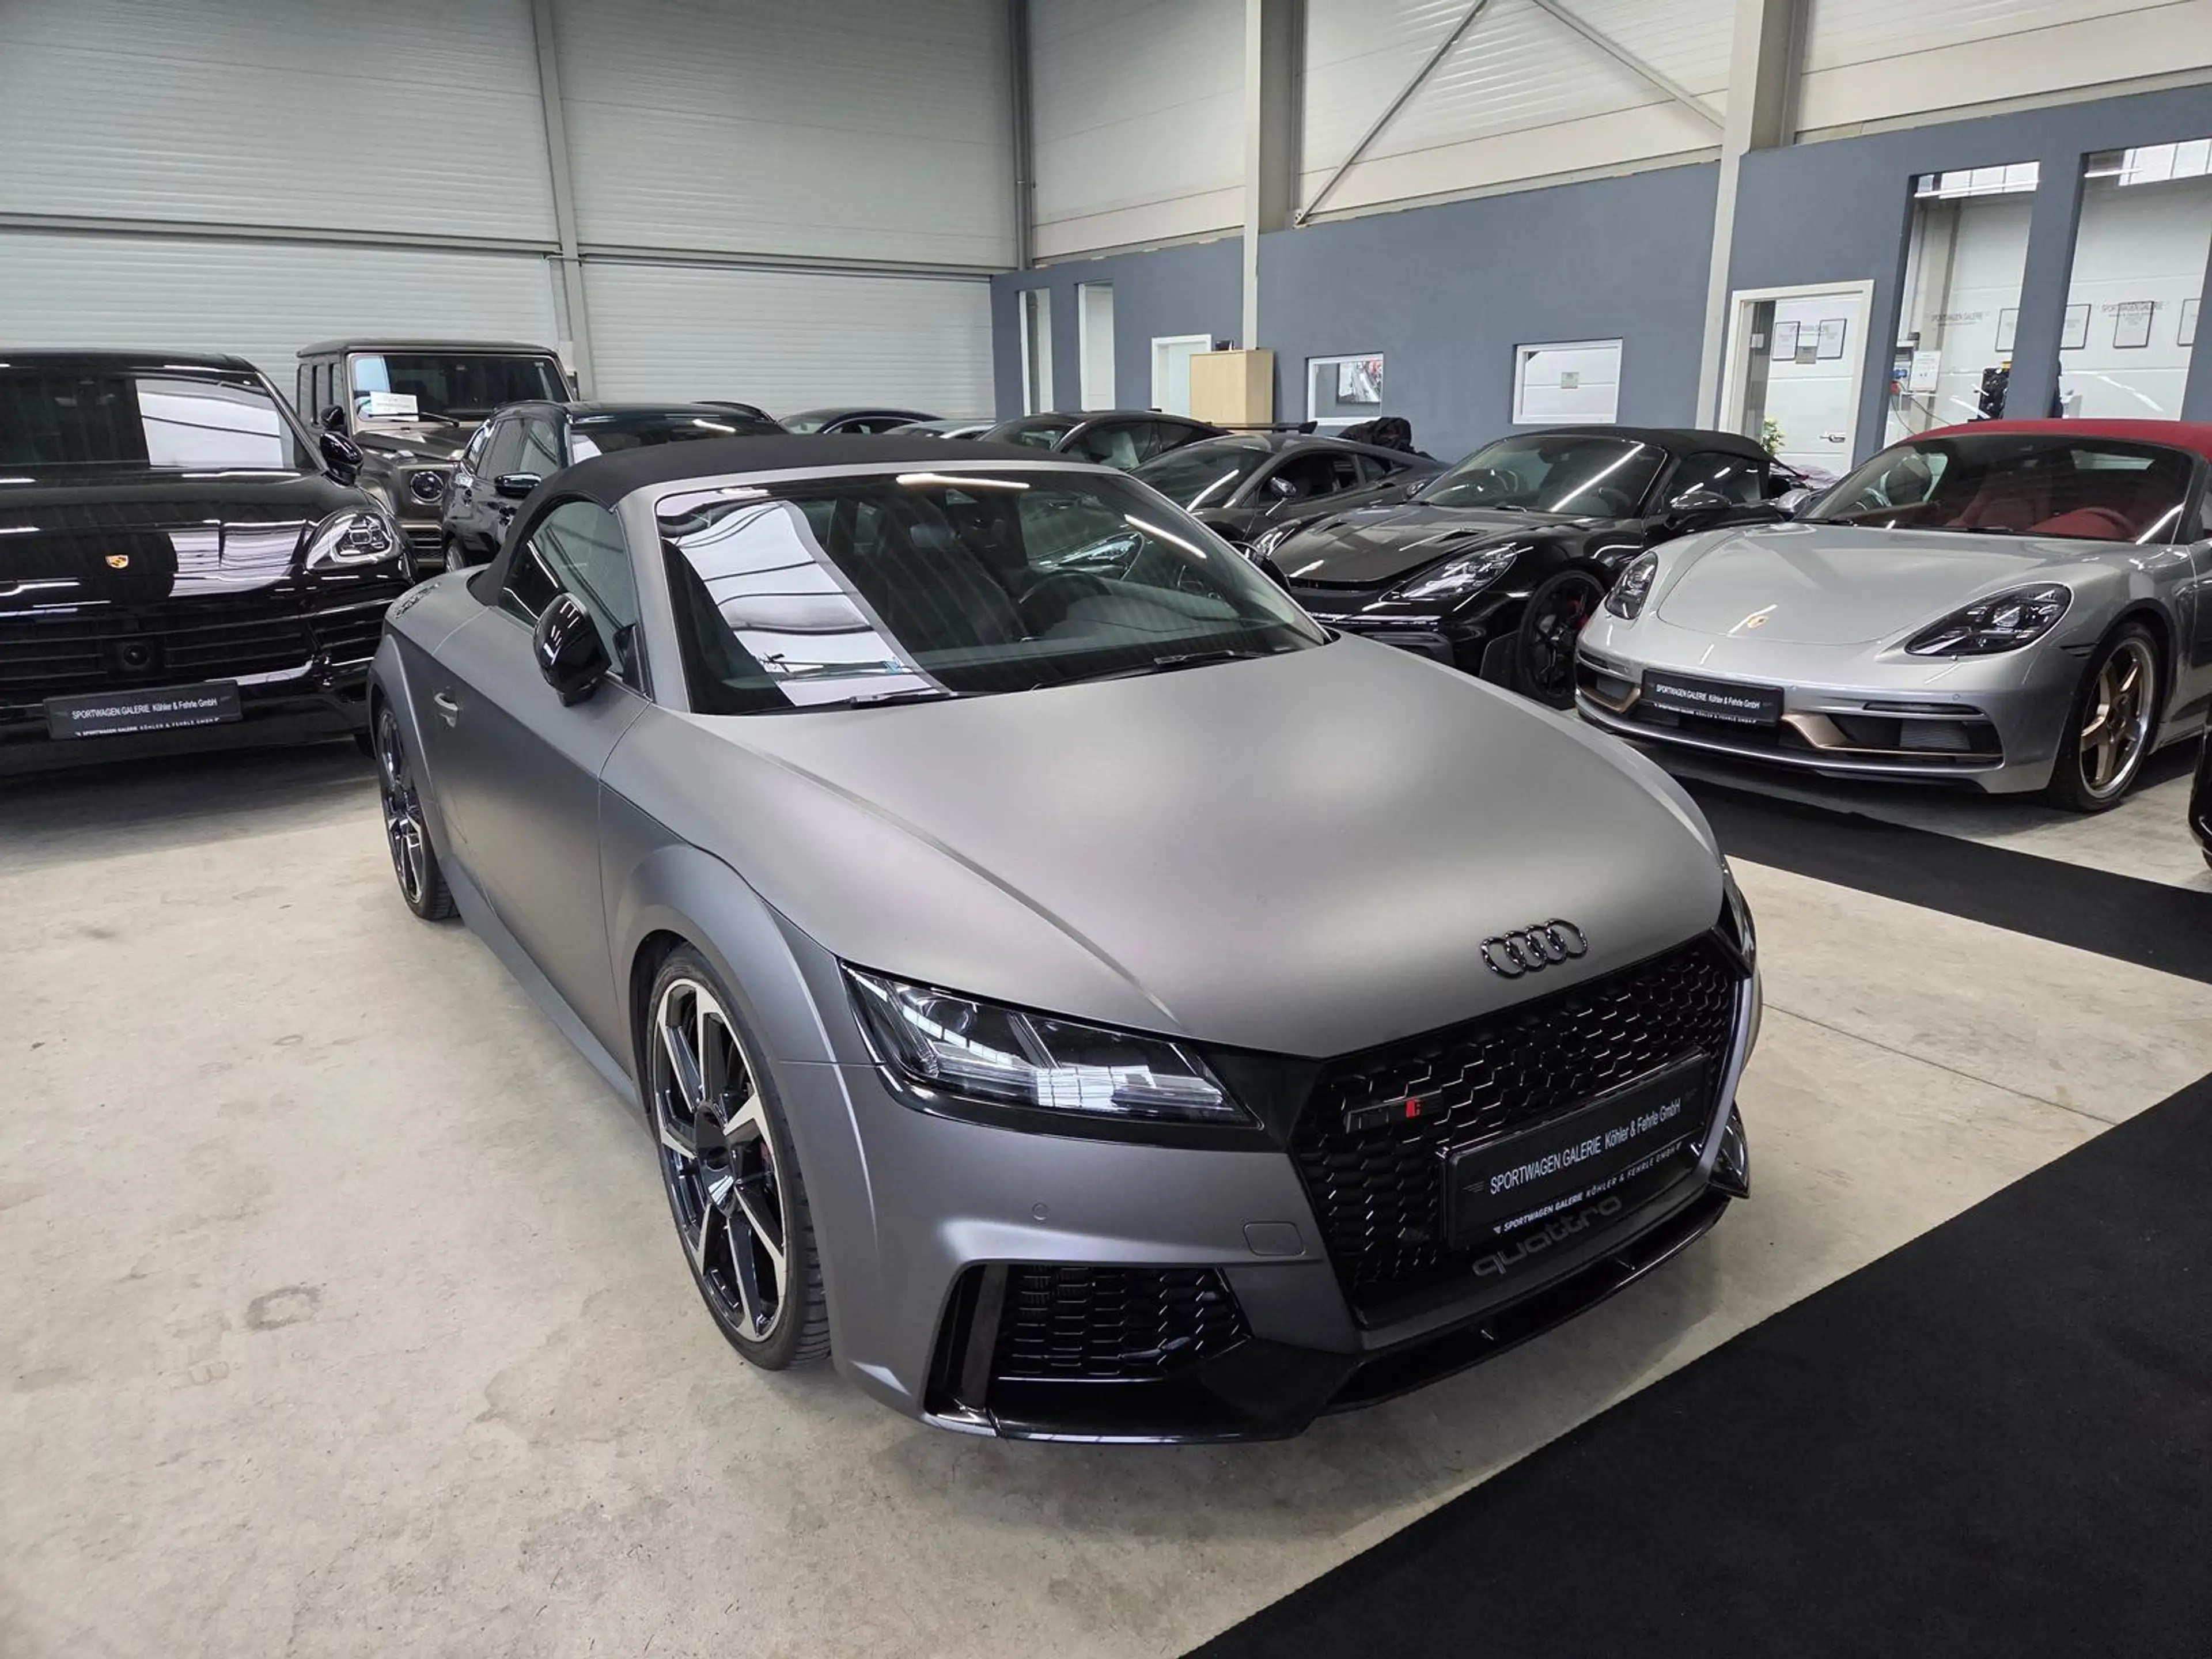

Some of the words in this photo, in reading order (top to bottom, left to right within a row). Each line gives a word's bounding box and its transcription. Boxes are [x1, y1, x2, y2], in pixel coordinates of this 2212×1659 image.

[71, 706, 121, 720] SPORTWAGEN
[122, 703, 151, 716] GALERIE
[173, 702, 178, 710] &
[198, 698, 217, 707] GmbH
[1490, 1153, 1561, 1195] SPORTWAGEN
[1562, 1135, 1602, 1167] GALERIE
[1604, 1127, 1630, 1150] Köhler
[1630, 1120, 1636, 1138] &
[1637, 1110, 1659, 1135] Fehrle
[1659, 1097, 1681, 1122] GmbH
[1503, 1204, 1554, 1233] SPORTWAGEN
[1555, 1191, 1584, 1211] GALERIE
[1585, 1177, 1617, 1198] KÖHLER
[1619, 1173, 1625, 1183] &
[1627, 1158, 1654, 1179] FEHRLE
[1471, 1195, 1623, 1277] quattro
